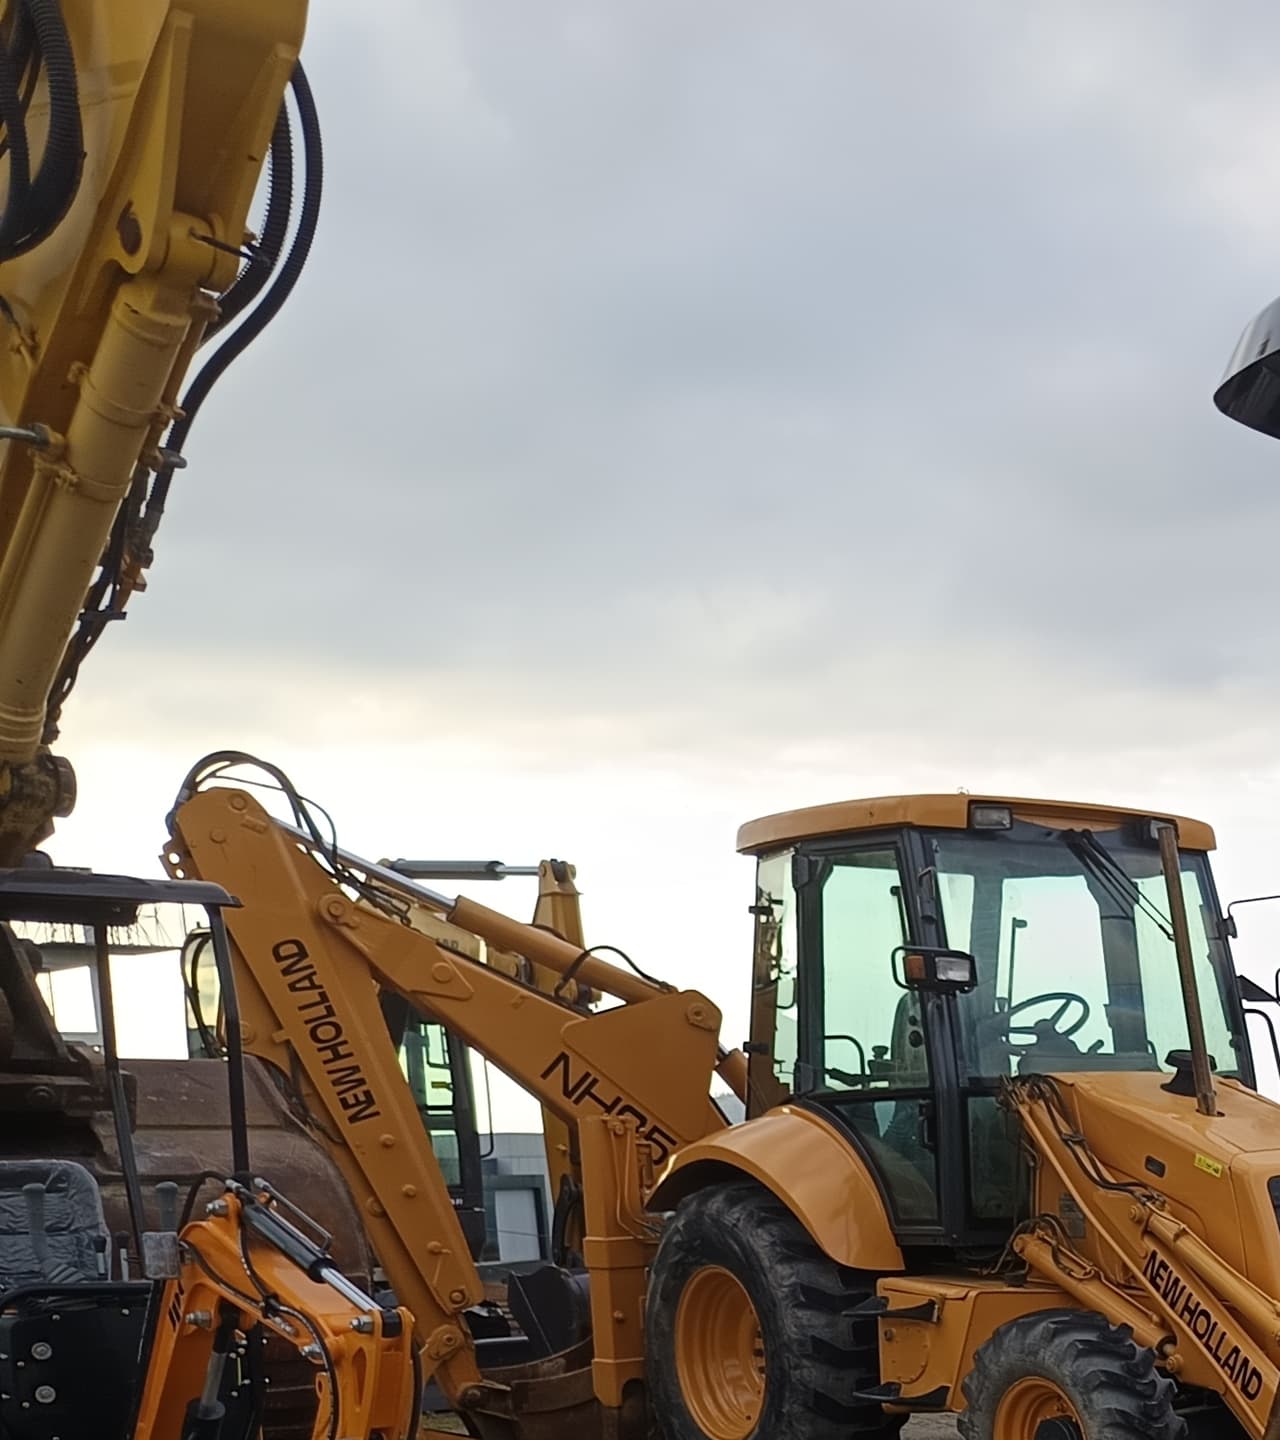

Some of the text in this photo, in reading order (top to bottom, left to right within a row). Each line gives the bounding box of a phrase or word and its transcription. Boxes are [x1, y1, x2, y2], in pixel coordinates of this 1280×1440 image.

[272, 939, 381, 1124] NEW HOLLAND
[1143, 1249, 1263, 1401] NEW HOLLAND
